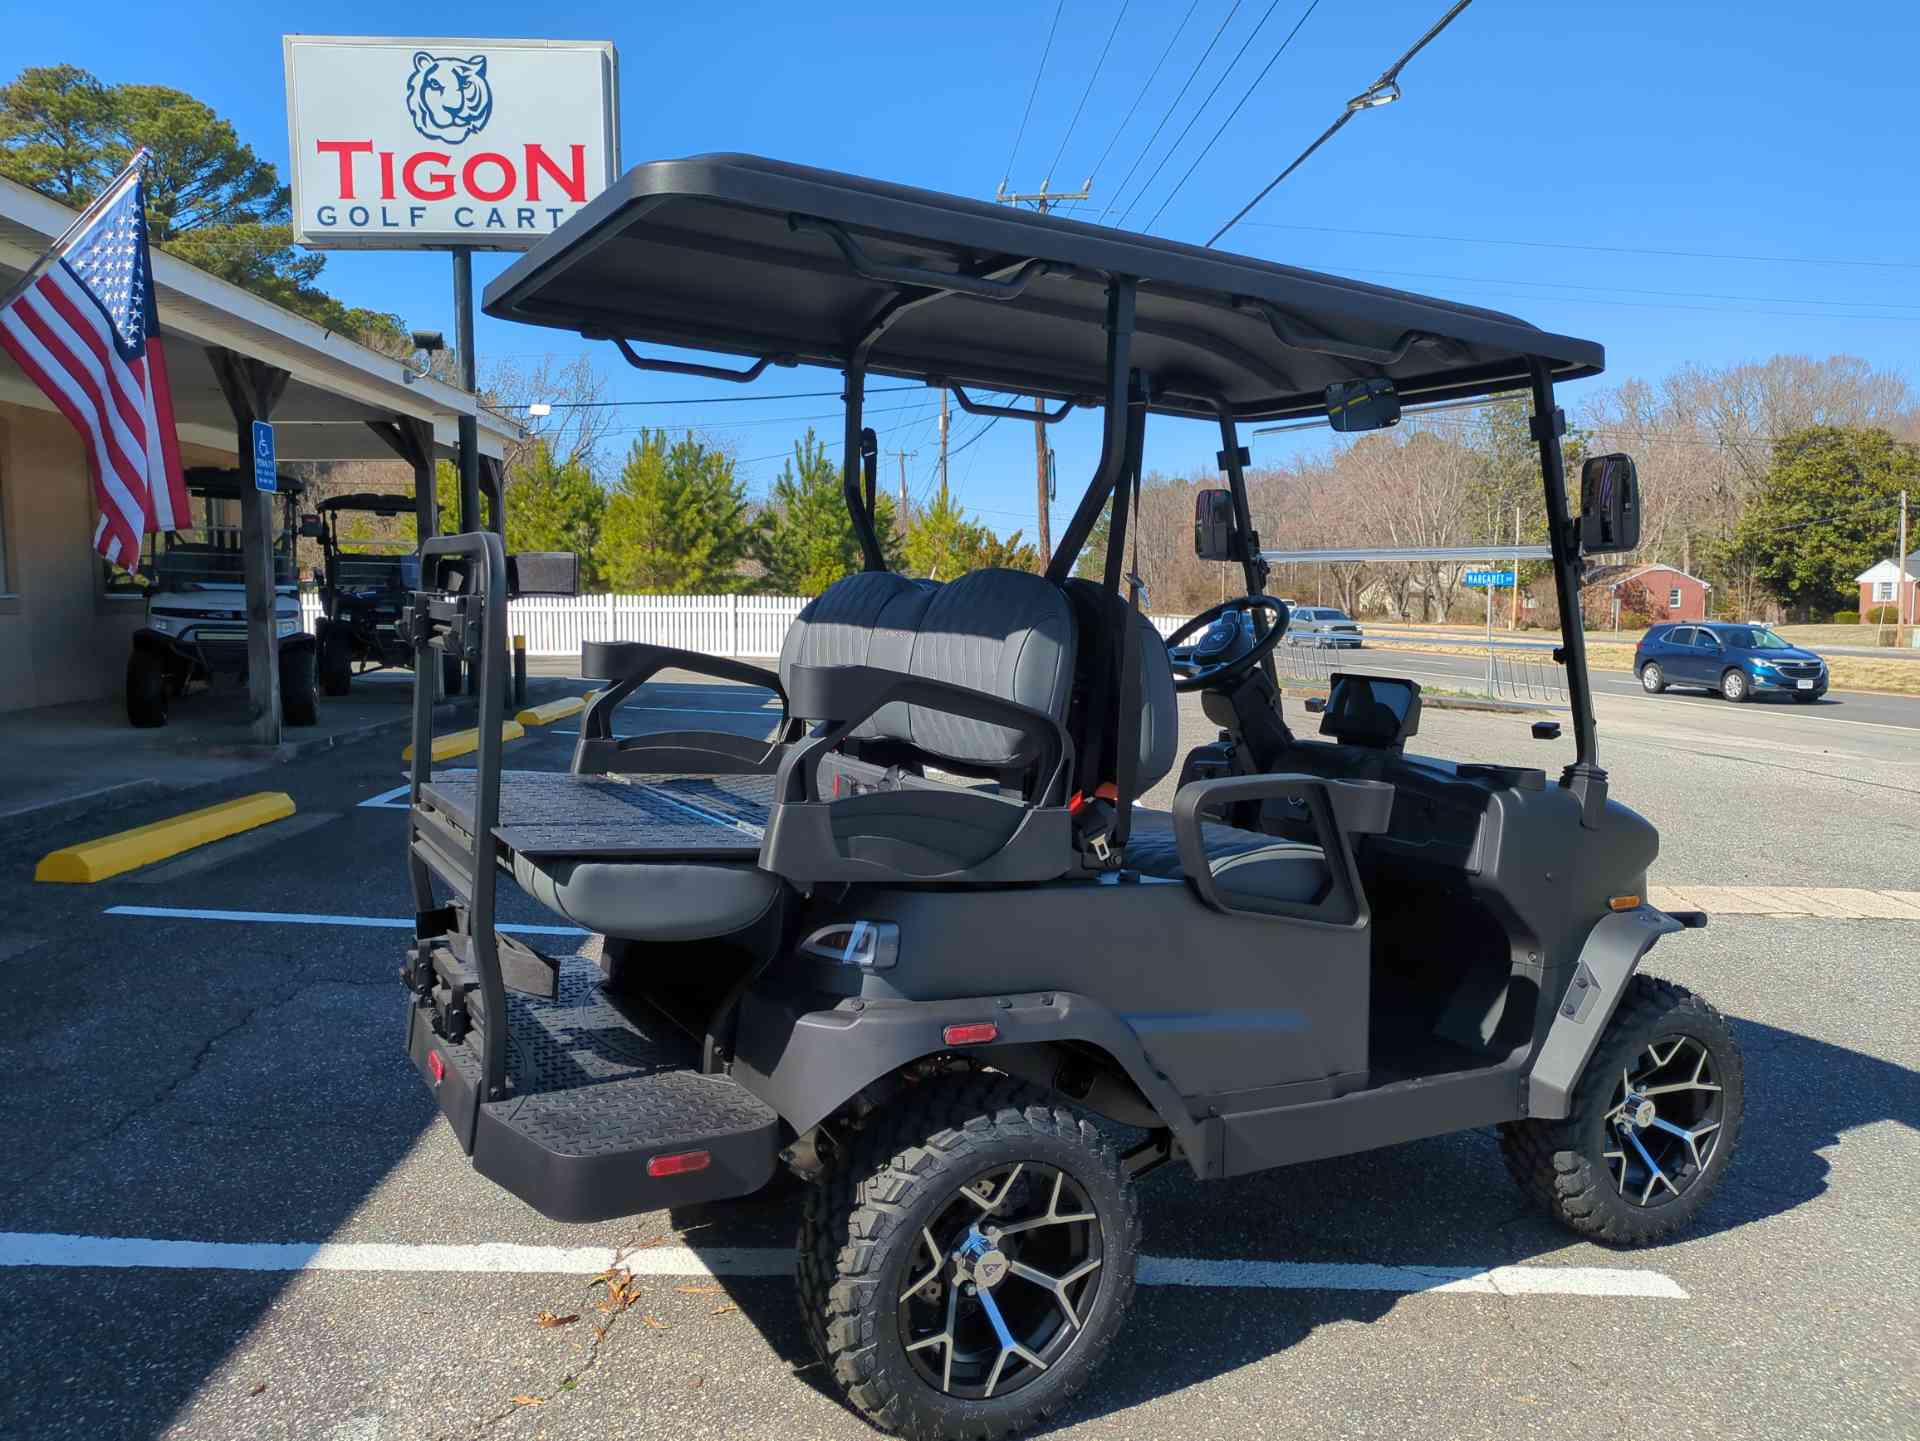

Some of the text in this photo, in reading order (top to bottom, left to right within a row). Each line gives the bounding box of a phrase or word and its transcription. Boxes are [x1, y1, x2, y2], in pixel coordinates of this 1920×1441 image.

[316, 138, 588, 202] TIGON
[317, 205, 564, 229] GOLF CART
[1468, 574, 1505, 585] MARGARET
